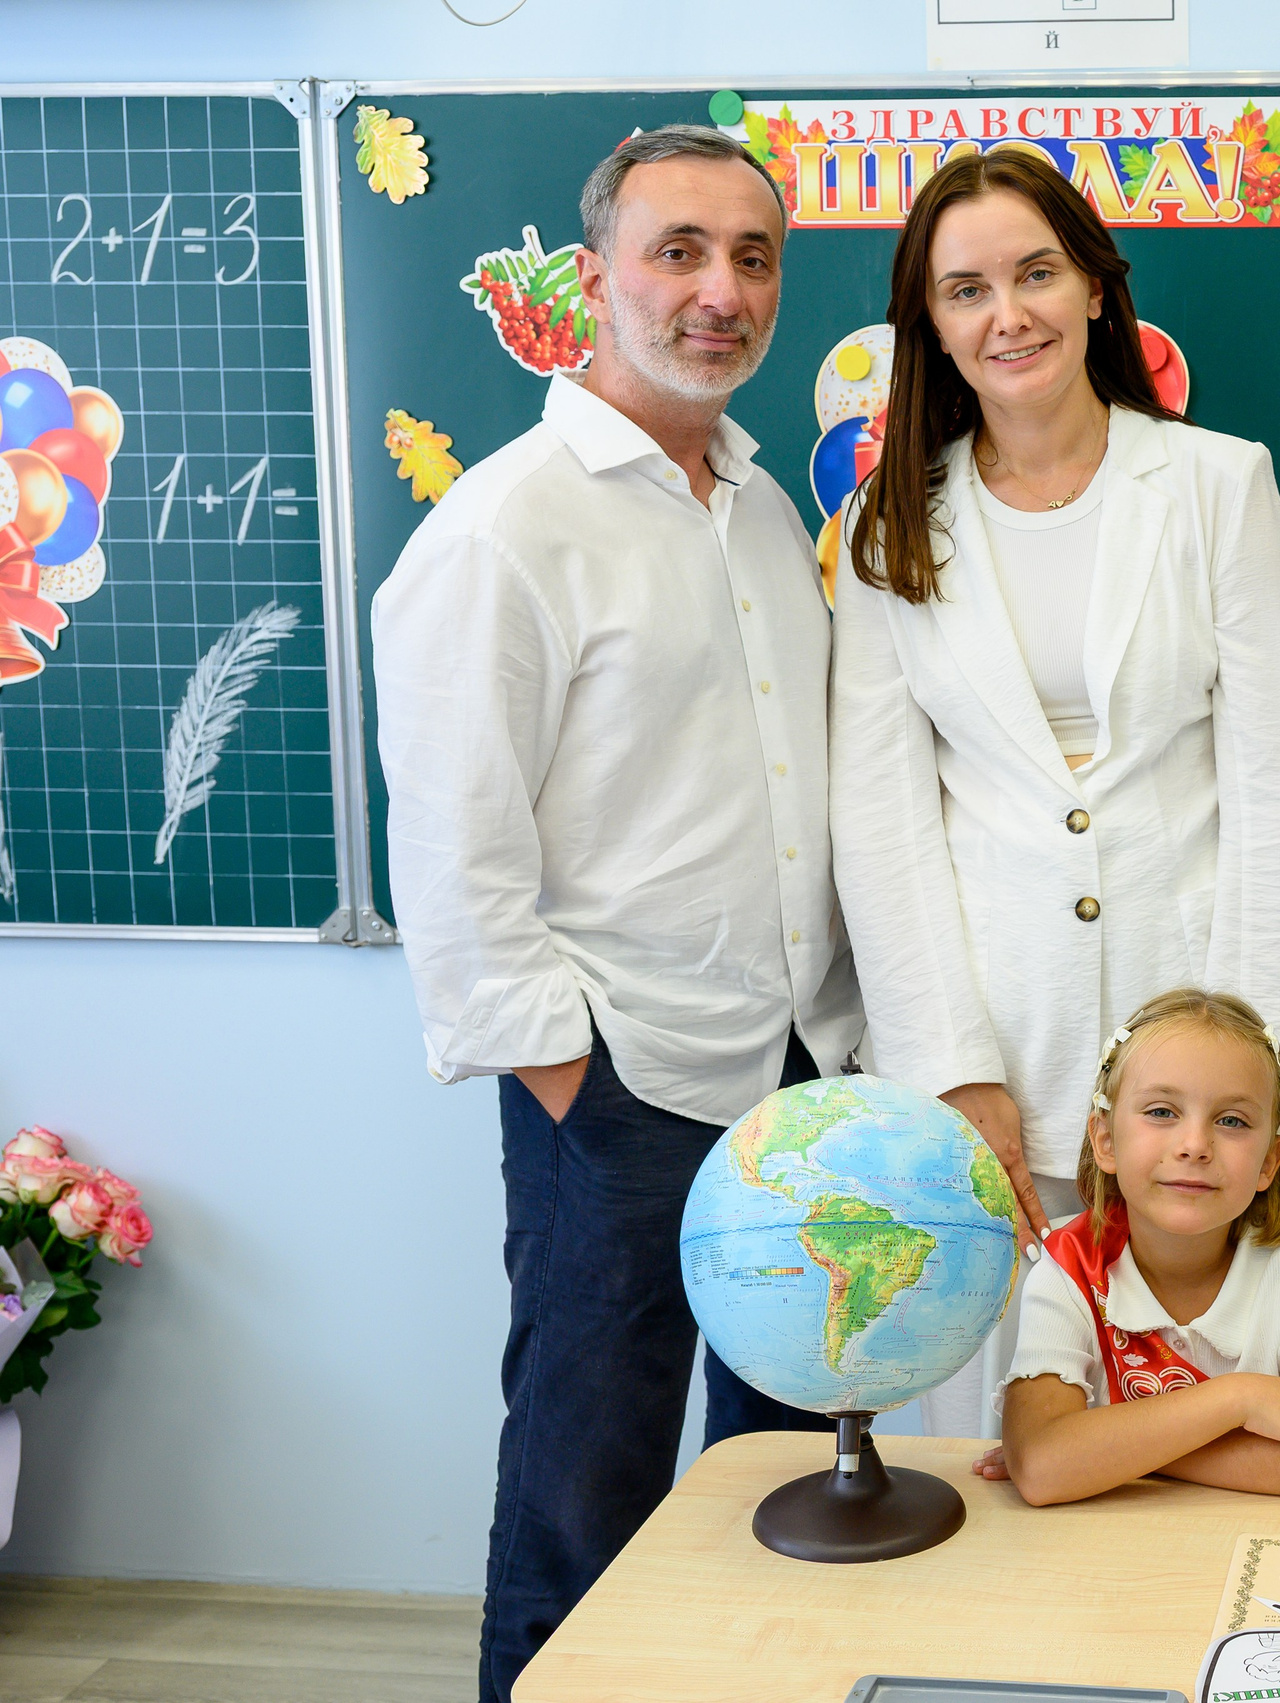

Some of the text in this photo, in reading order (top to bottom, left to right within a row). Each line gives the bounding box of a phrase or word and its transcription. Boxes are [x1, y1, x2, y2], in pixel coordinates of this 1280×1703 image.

[1045, 30, 1060, 49] Й
[830, 101, 1224, 148] ЗДРАВСТВУЙ,
[790, 139, 1246, 224] ШЛА!
[51, 193, 260, 286] 2+1=3
[152, 454, 299, 546] 1+1=
